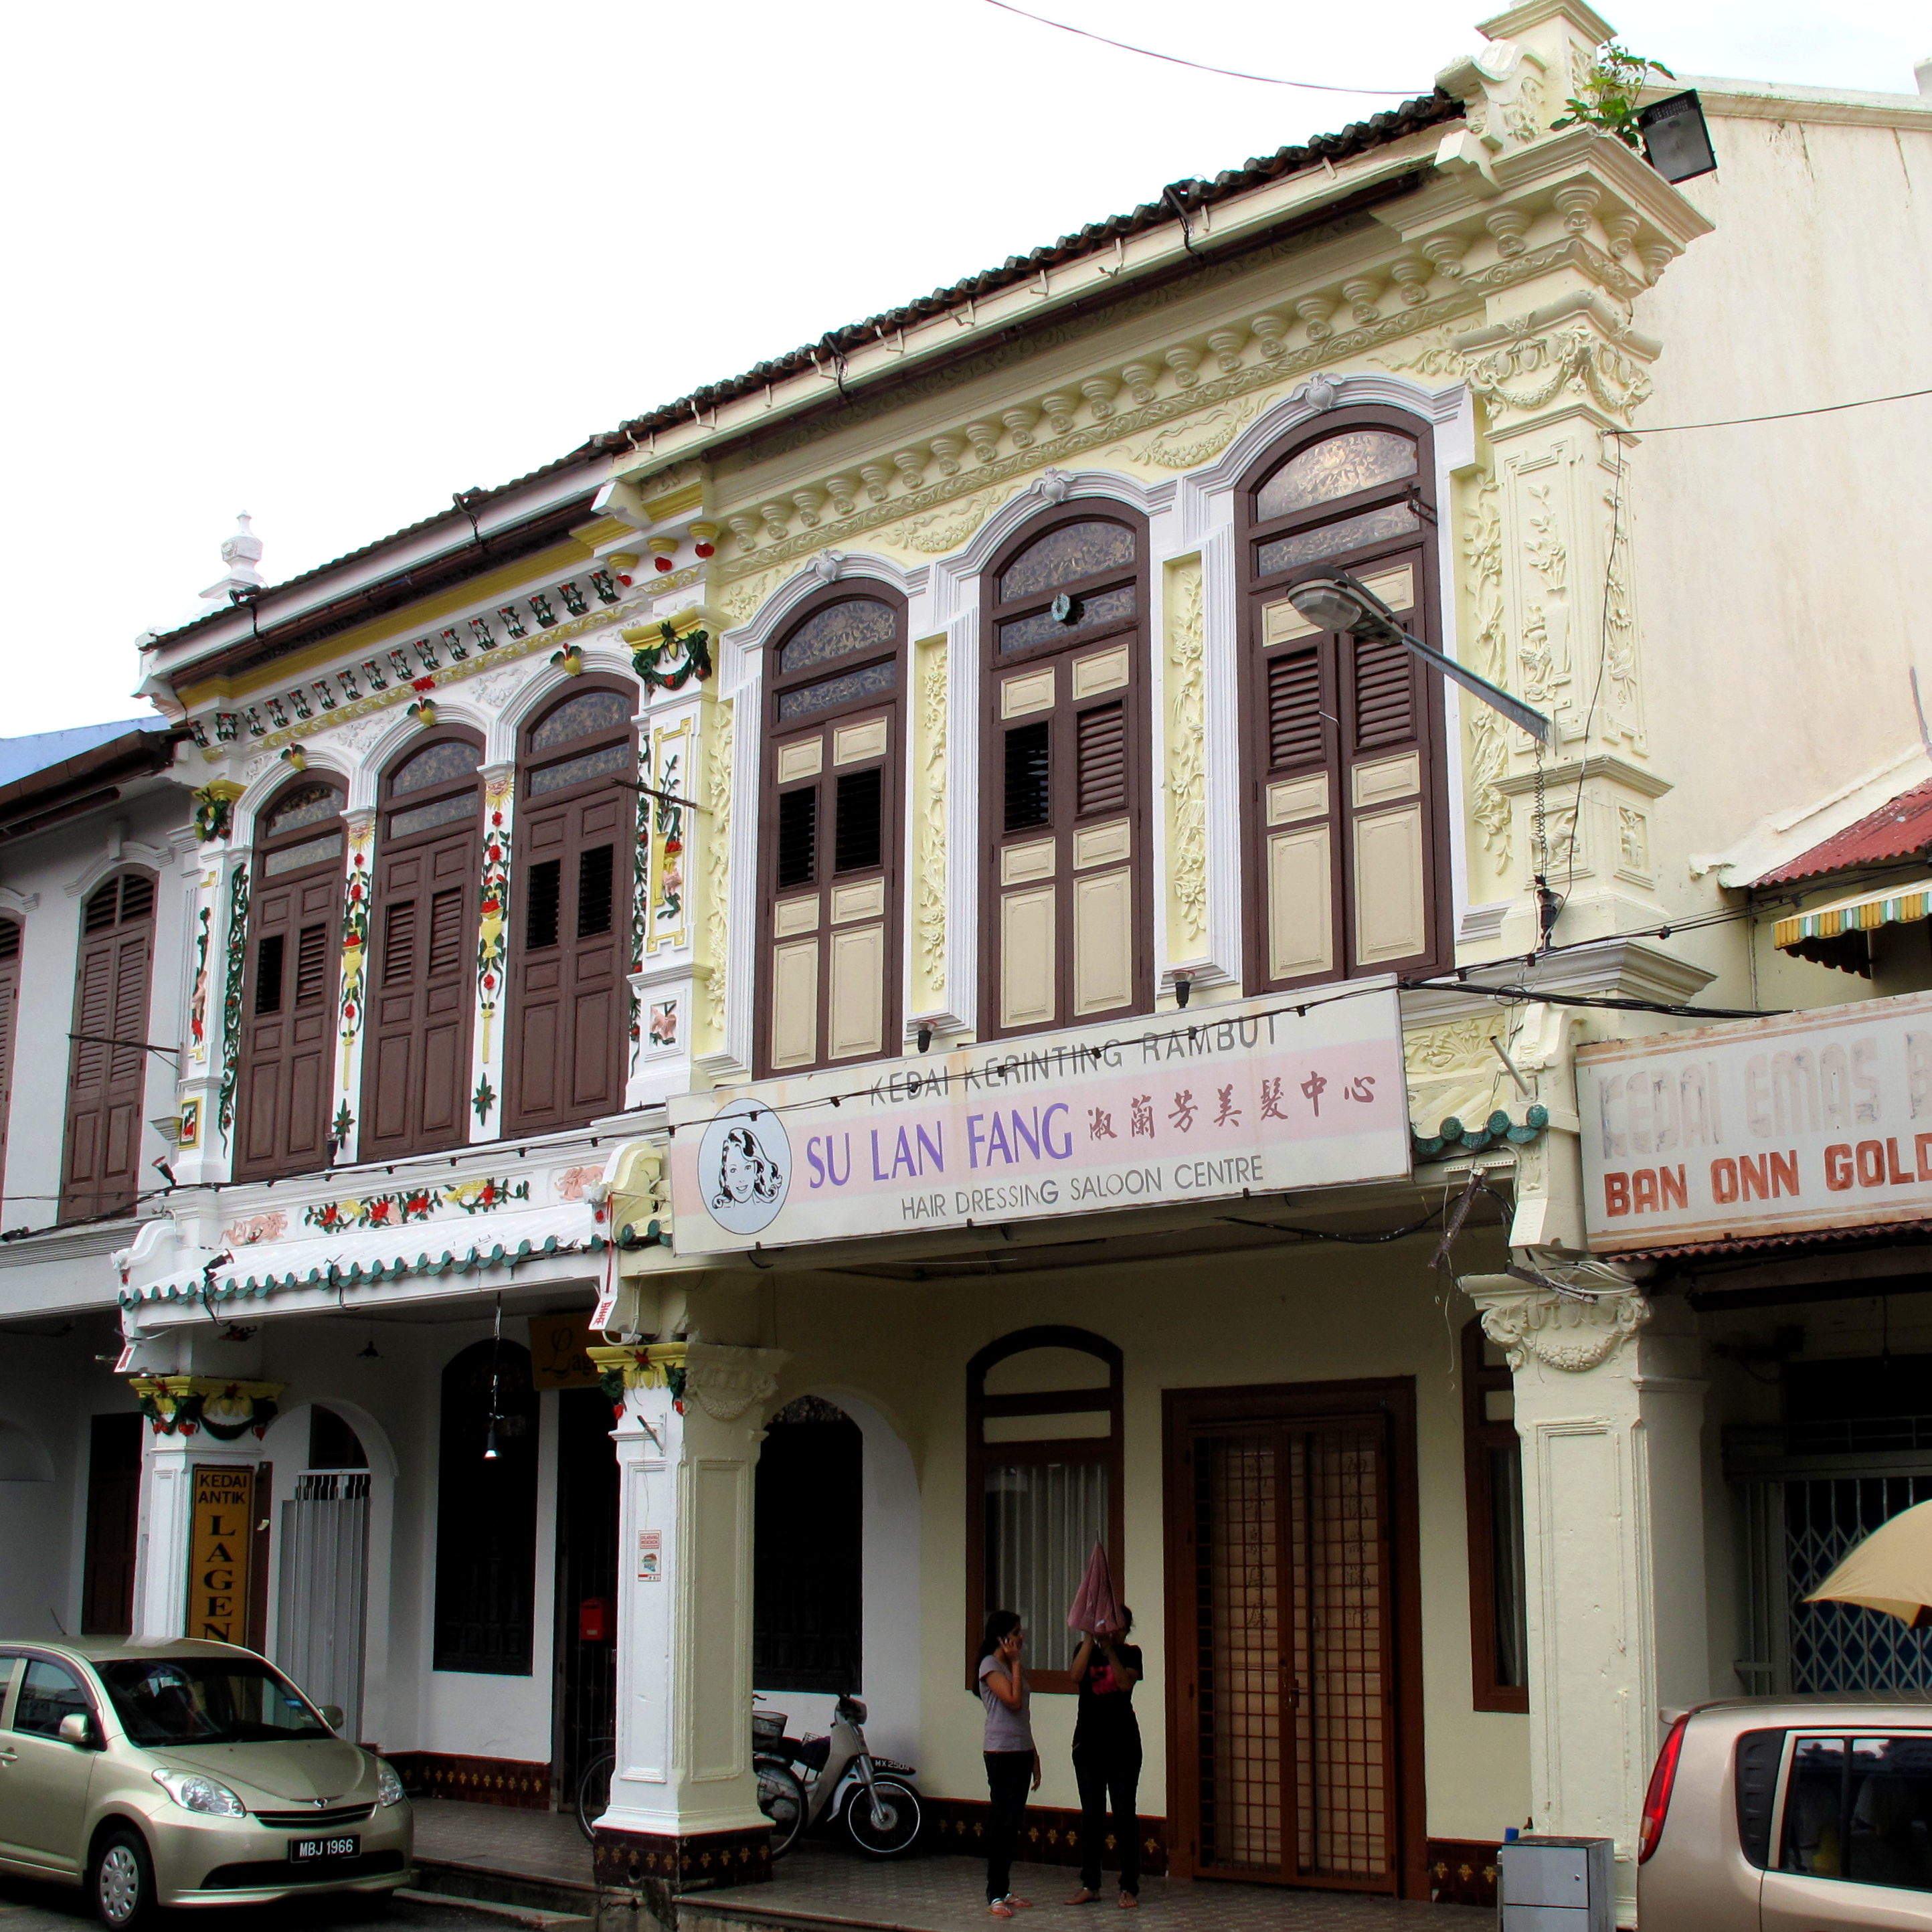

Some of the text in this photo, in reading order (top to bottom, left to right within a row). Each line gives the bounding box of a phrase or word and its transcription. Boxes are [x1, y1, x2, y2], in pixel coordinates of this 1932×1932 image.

[871, 1013, 1278, 1106] KEDAI KERINTING RAMBUT
[1744, 1037, 1882, 1139] EMAS
[1087, 1071, 1376, 1141] 淑蘭芳美髮中心
[806, 1102, 1073, 1189] SU LAN FANG
[901, 1154, 1263, 1220] HAIR DRESSING SALOON CENTRE
[1604, 1164, 1688, 1217] BAN
[1710, 1150, 1799, 1205] ONN
[199, 1491, 246, 1504] ANTIK
[200, 1474, 247, 1487] KEDAI
[299, 1838, 353, 1858] MBJ 1966
